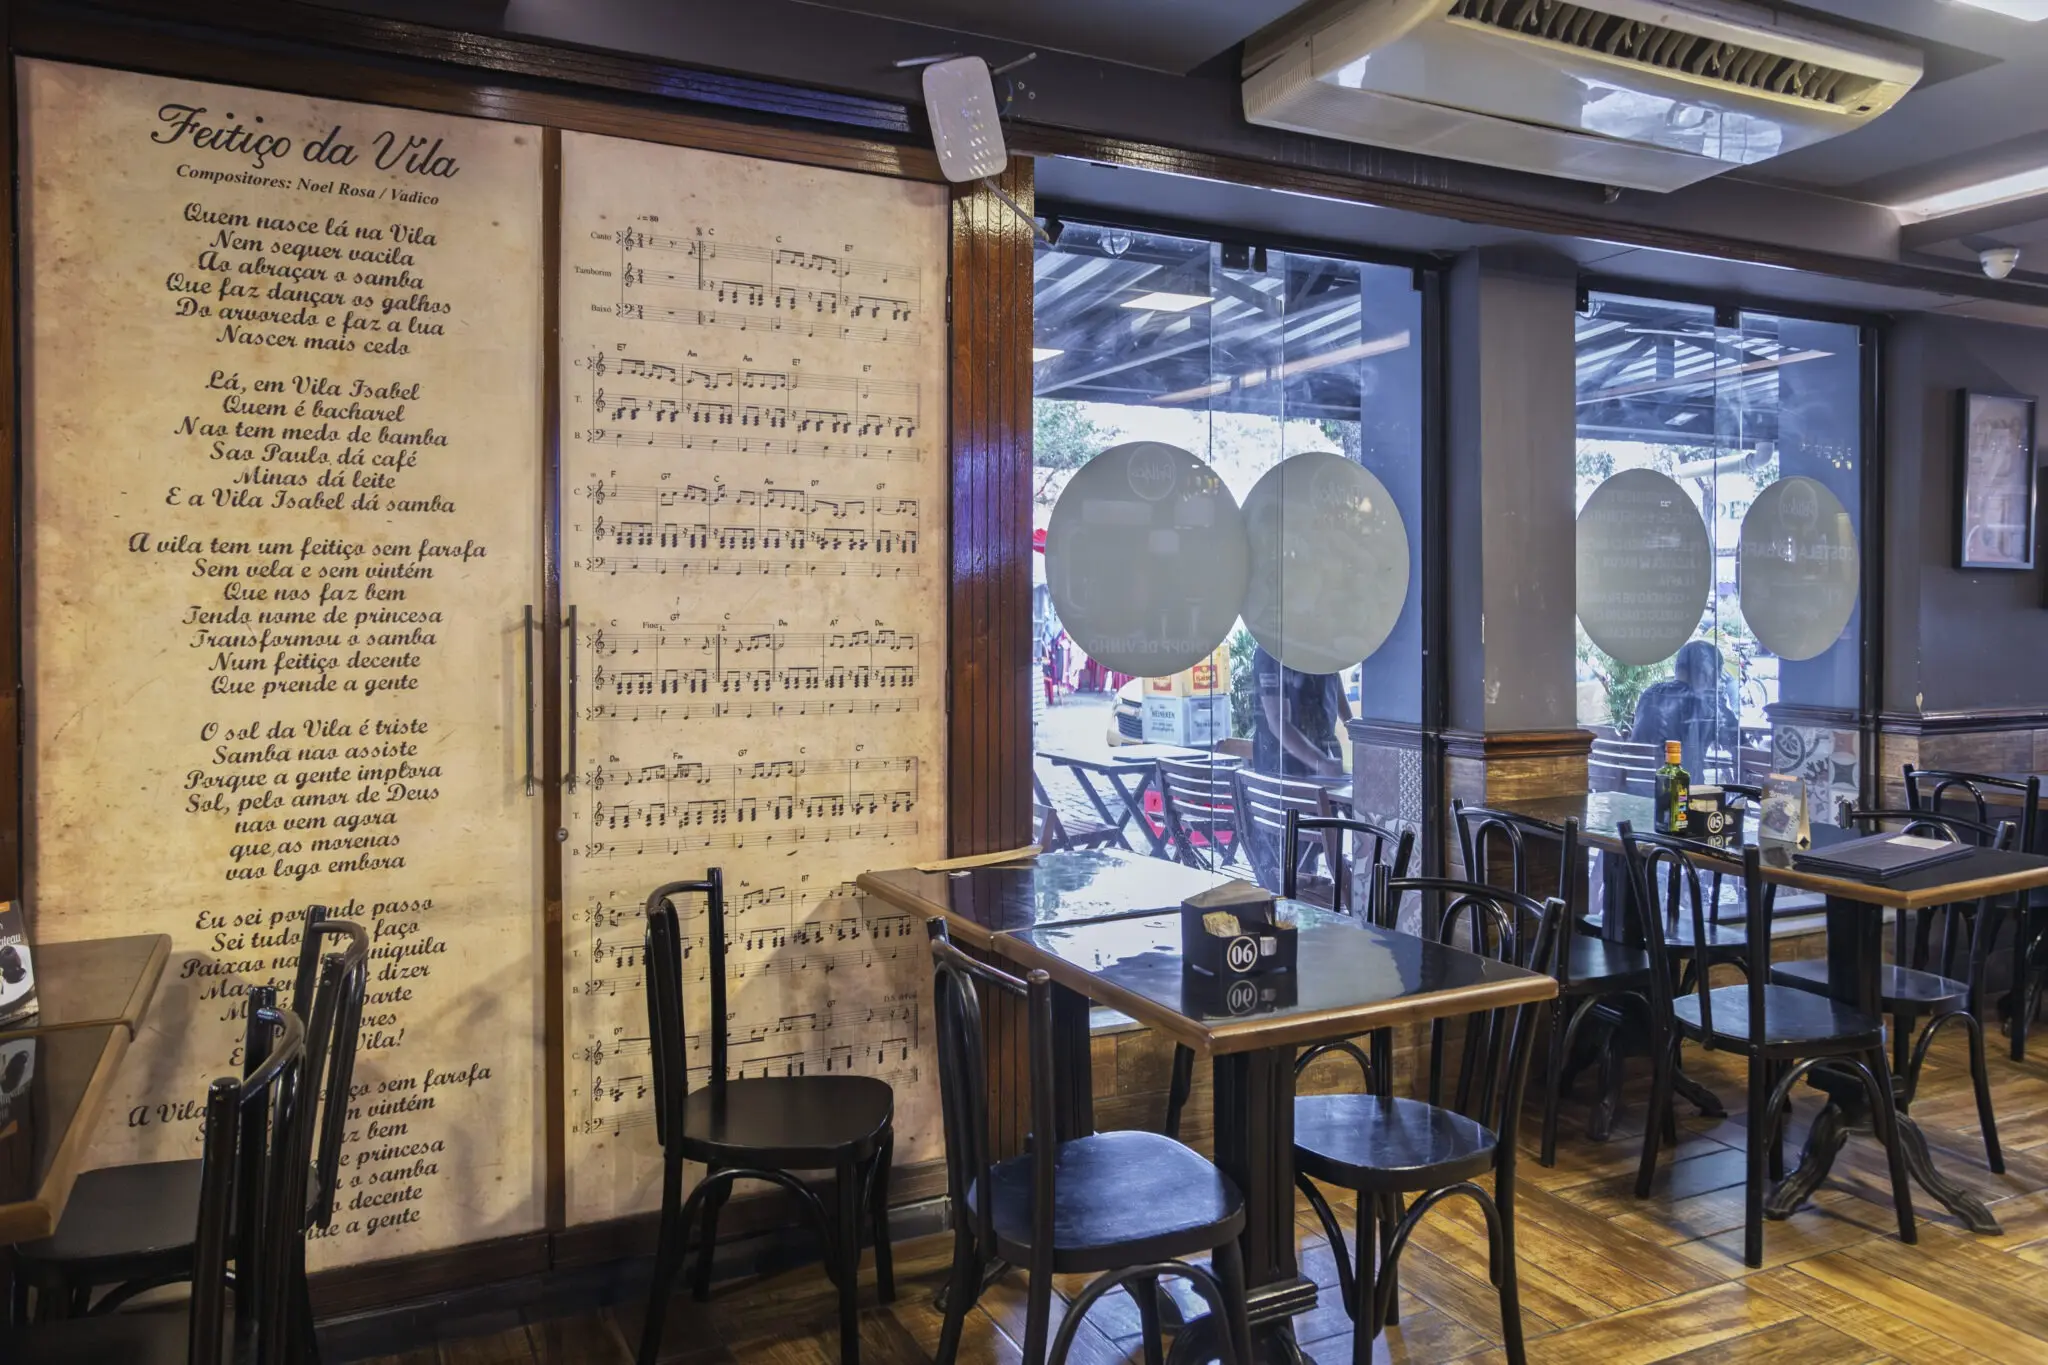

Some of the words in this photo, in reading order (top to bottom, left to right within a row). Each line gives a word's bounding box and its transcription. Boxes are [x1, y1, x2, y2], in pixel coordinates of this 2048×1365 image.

[151, 104, 291, 169] Feitiço
[303, 126, 358, 166] da
[372, 131, 460, 178] Vila
[177, 164, 292, 189] Compositores:
[297, 178, 334, 193] Noel
[338, 183, 375, 198] Rosa
[379, 188, 387, 199] /
[392, 189, 439, 205] Vadico
[184, 203, 250, 227] Quem
[256, 217, 319, 234] nasce
[325, 218, 349, 237] lá
[355, 227, 383, 240] na
[390, 224, 437, 246] Vila
[590, 231, 612, 241] Canto
[209, 229, 263, 252] Nem
[271, 242, 343, 261] sequer
[349, 247, 415, 266] vacila
[198, 251, 232, 272] Ao
[238, 257, 328, 284] abraçar
[334, 272, 347, 282] o
[353, 270, 424, 289] samba
[574, 265, 612, 278] Tamborim
[166, 273, 211, 294] Que
[218, 277, 260, 301] faz
[266, 282, 345, 308] dançar
[352, 296, 373, 307] os
[382, 294, 451, 315] galhos
[175, 297, 212, 317] Do
[219, 307, 319, 326] arvoredo
[326, 316, 336, 327] e
[342, 311, 381, 338] faz
[387, 321, 401, 332] a
[408, 316, 445, 336] lua
[591, 304, 612, 313] Baixo
[216, 325, 298, 348] Nascer
[304, 337, 355, 351] mais
[364, 337, 410, 355] cedo
[205, 370, 246, 394] Lá,
[254, 380, 285, 393] em
[292, 376, 342, 396] Vila
[349, 379, 420, 400] Isabel
[222, 395, 287, 416] Quem
[294, 400, 305, 417] é
[312, 400, 405, 422] bacharel
[174, 416, 228, 436] Nao
[236, 422, 275, 438] tem
[282, 423, 340, 441] medo
[347, 425, 371, 443] de
[378, 426, 448, 446] bamba
[210, 441, 254, 461] Sao
[261, 443, 330, 464] Paulo
[337, 447, 365, 465] dá
[372, 449, 417, 472] café
[233, 466, 307, 486] Minas
[317, 469, 345, 487] dá
[352, 470, 395, 489] leite
[166, 487, 181, 505] E
[188, 495, 205, 506] a
[212, 488, 263, 508] Vila
[271, 490, 344, 510] Isabel
[351, 493, 380, 511] dá
[386, 495, 456, 513] samba
[129, 532, 150, 552] A
[157, 535, 203, 553] vila
[210, 538, 251, 554] tem
[259, 543, 294, 555] um
[300, 537, 365, 560] feitiço
[372, 545, 411, 556] sem
[418, 539, 486, 562] farofa
[192, 558, 239, 577] Sem
[246, 560, 294, 578] vela
[301, 567, 312, 578] e
[318, 567, 360, 578] sem
[366, 562, 434, 579] vintém
[223, 582, 268, 600] Que
[274, 589, 310, 600] nos
[319, 583, 358, 606] faz
[365, 583, 406, 600] bem
[182, 605, 252, 624] Tendo
[259, 612, 316, 624] nome
[323, 605, 347, 623] de
[354, 607, 443, 629] princesa
[611, 619, 617, 627] C
[190, 629, 341, 653] Transformou
[347, 635, 360, 646] o
[366, 627, 436, 645] samba
[208, 652, 267, 671] Num
[274, 651, 340, 676] feitiço
[346, 650, 420, 668] decente
[211, 676, 255, 694] Que
[262, 674, 337, 699] prende
[343, 680, 358, 691] a
[365, 675, 418, 696] gente
[200, 722, 218, 741] O
[224, 721, 260, 741] sol
[266, 720, 296, 739] da
[303, 719, 352, 737] Vila
[359, 719, 370, 736] é
[376, 719, 428, 735] triste
[212, 744, 291, 764] Samba
[298, 749, 338, 760] nao
[345, 741, 417, 759] assiste
[184, 770, 267, 793] Porque
[274, 773, 289, 785] a
[296, 767, 351, 790] gente
[357, 761, 442, 785] implora
[185, 793, 230, 815] Sol,
[238, 790, 285, 816] pelo
[291, 793, 349, 807] amor
[356, 785, 380, 803] de
[384, 782, 439, 802] Deus
[235, 820, 277, 833] nao
[284, 817, 327, 830] vem
[333, 813, 397, 832] agora
[1710, 816, 1722, 829] 05
[311, 835, 400, 851] morenas
[226, 867, 267, 880] vao
[274, 859, 321, 881] logo
[328, 852, 406, 873] embora
[196, 911, 227, 929] Eu
[233, 909, 262, 927] sei
[371, 899, 434, 920] passo
[0, 933, 21, 946] ateau
[211, 933, 244, 952] Sei
[251, 927, 299, 948] tudo
[374, 919, 419, 942] faço
[1231, 943, 1253, 965] 06
[180, 959, 265, 978] Paixao
[378, 962, 430, 981] dizer
[378, 1078, 416, 1093] sem
[424, 1063, 491, 1093] farofa
[368, 1094, 435, 1117] vintém
[367, 1121, 408, 1139] bem
[356, 1140, 445, 1170] princesa
[369, 1159, 438, 1184] samba
[349, 1186, 423, 1210] decente
[367, 1208, 420, 1236] gente
